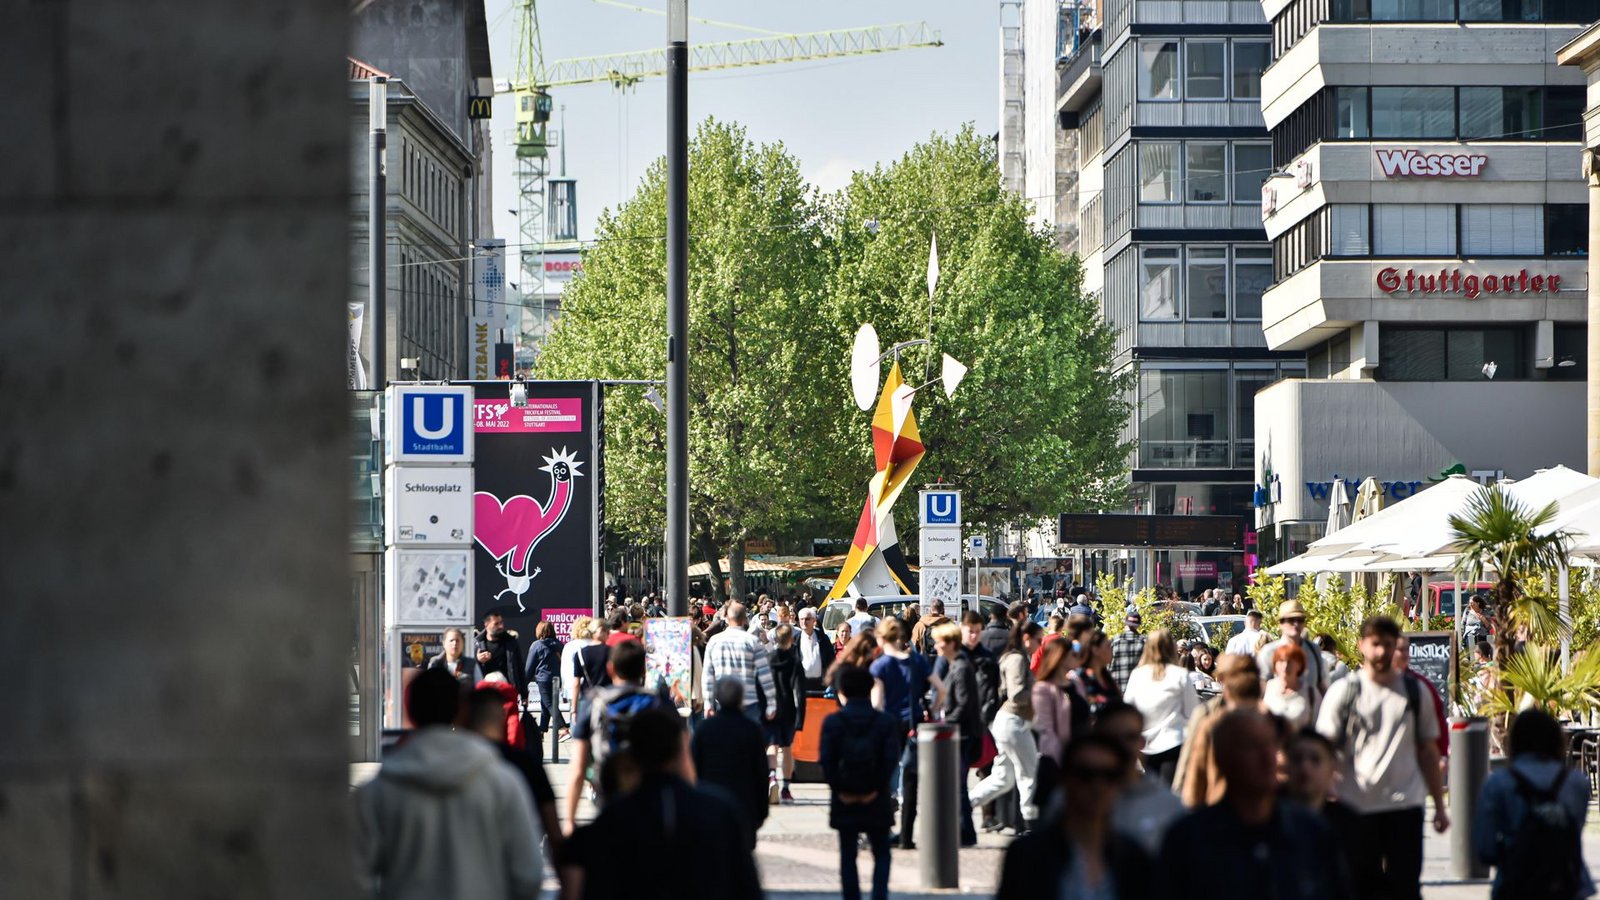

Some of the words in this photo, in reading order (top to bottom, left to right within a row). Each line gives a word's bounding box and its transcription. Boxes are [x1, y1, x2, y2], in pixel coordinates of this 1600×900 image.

[1375, 149, 1488, 177] Wesser
[1376, 267, 1562, 300] Stuttgarter
[413, 397, 454, 440] U
[405, 483, 461, 493] Schlossplatz
[931, 495, 952, 517] U
[546, 612, 575, 623] ZURÜCK
[553, 622, 573, 634] ERZ
